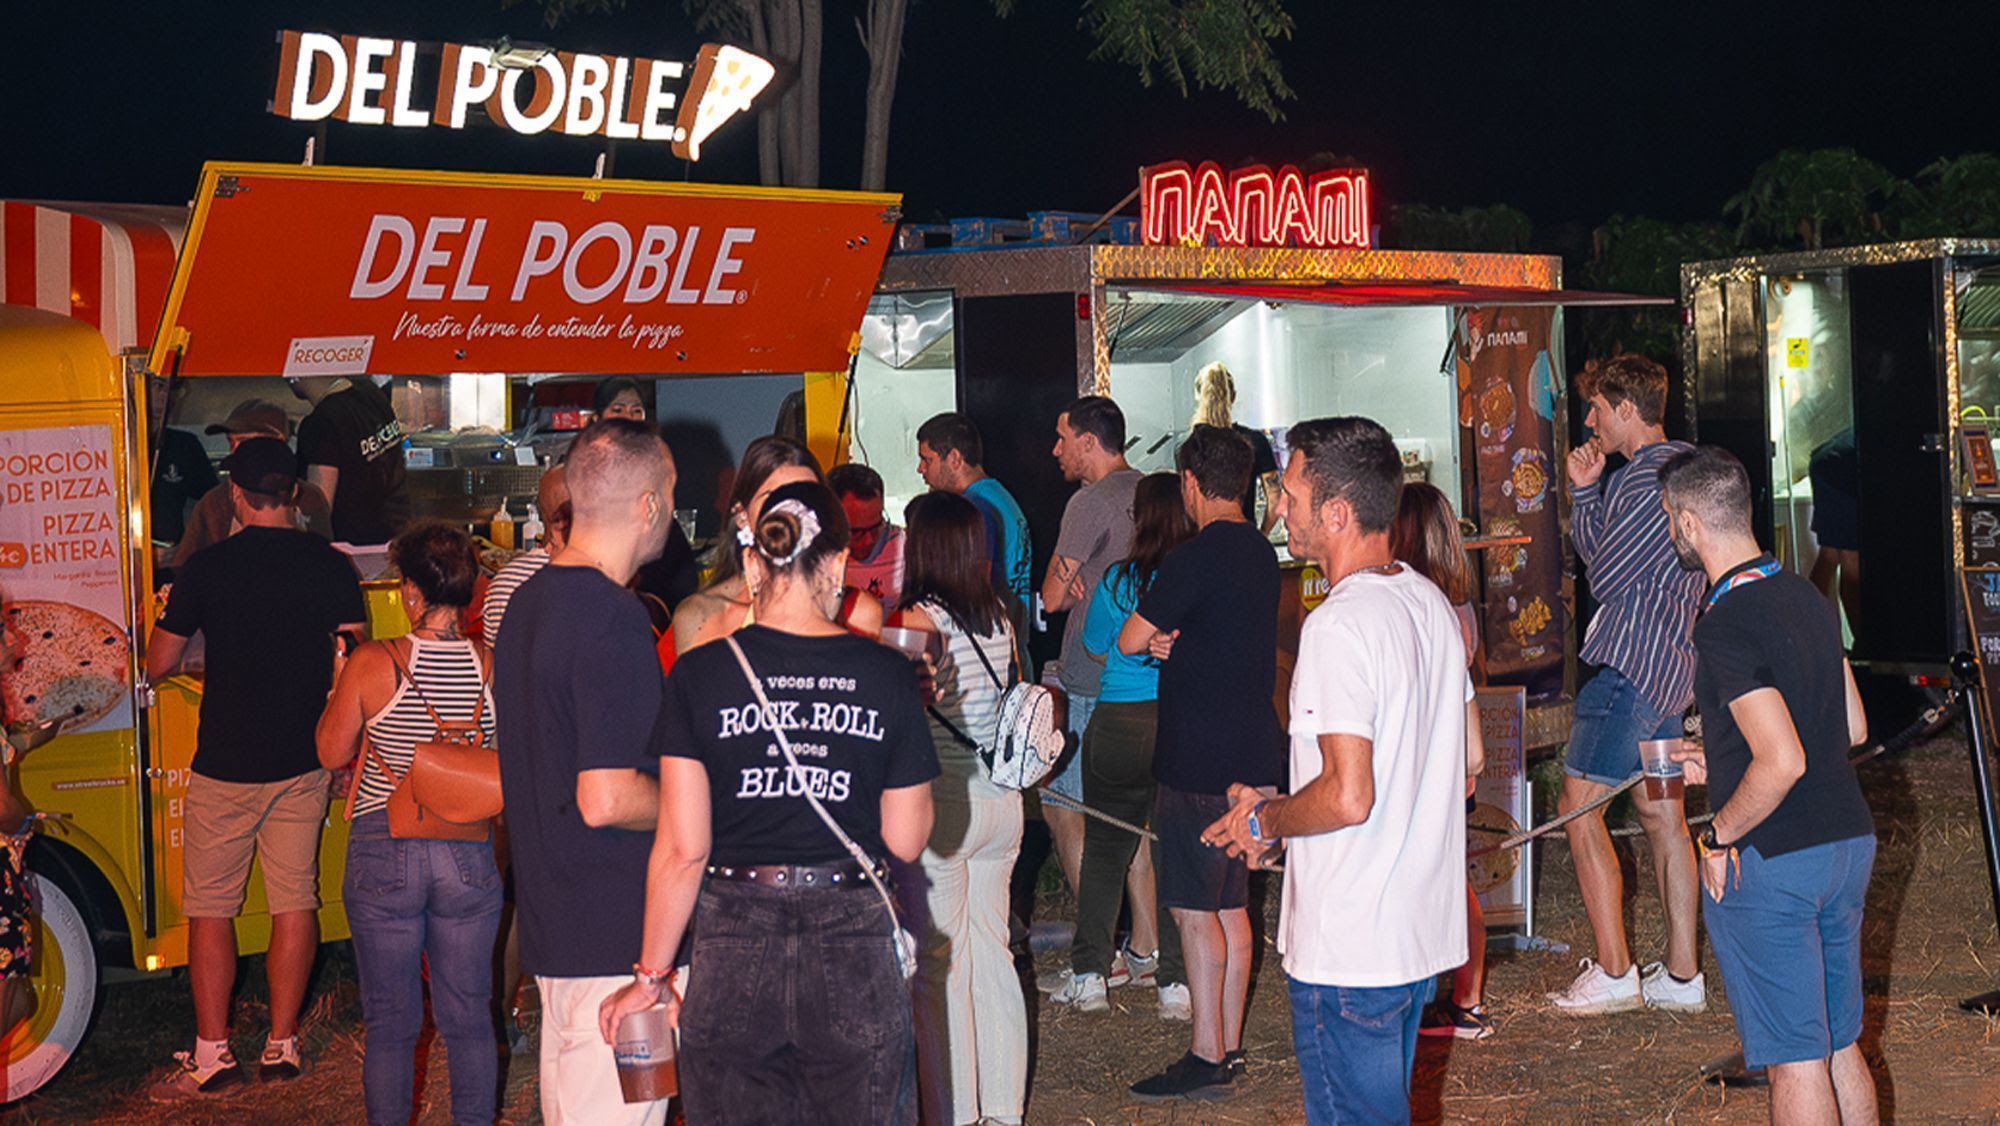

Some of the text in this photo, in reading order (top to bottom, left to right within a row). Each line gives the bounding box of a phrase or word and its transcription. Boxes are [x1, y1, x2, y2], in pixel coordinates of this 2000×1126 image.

[290, 32, 430, 128] DEL
[350, 214, 489, 301] DEL
[392, 310, 684, 349] Nuestra forma de entender la pizza
[294, 347, 364, 364] RECOGER
[7, 476, 111, 504] DE PIZZA
[44, 511, 113, 536] PIZZA
[30, 537, 115, 564] ENTERA
[767, 676, 815, 690] veces
[818, 677, 857, 692] eres
[718, 701, 800, 739] ROCK
[809, 702, 885, 741] ROLL
[736, 765, 852, 802] BLUES
